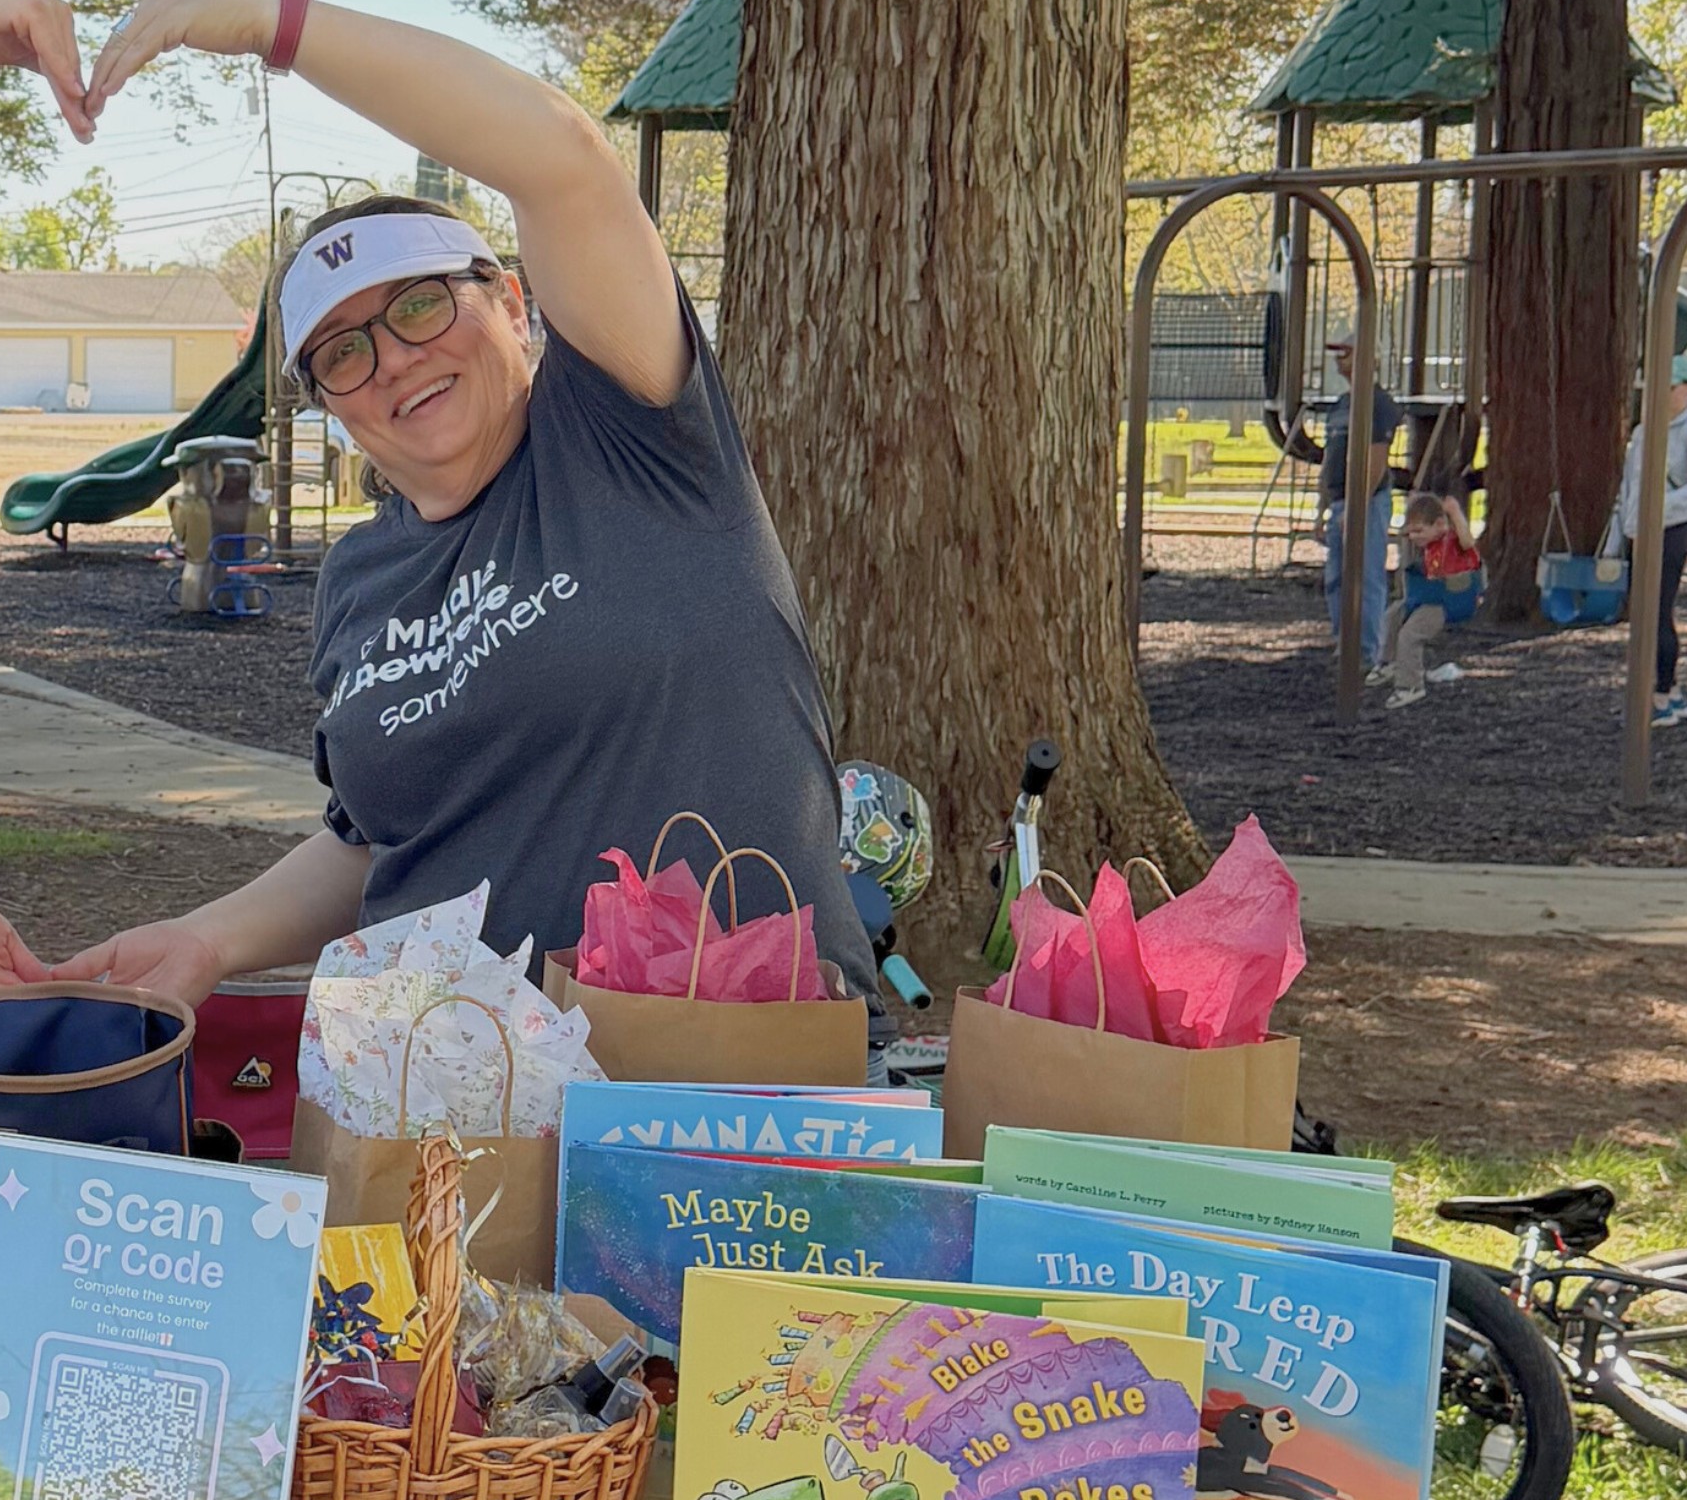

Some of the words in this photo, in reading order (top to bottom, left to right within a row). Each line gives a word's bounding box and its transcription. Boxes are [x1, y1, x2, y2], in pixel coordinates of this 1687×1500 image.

[314, 231, 354, 271] W
[379, 572, 579, 737] somewhere
[76, 1178, 224, 1245] Scan
[660, 1189, 811, 1233] Maybe
[1016, 1174, 1048, 1187] words
[1050, 1179, 1064, 1192] by
[1066, 1181, 1117, 1199] Caroline
[1134, 1193, 1167, 1208] Perry
[1203, 1204, 1254, 1221] pictures
[1257, 1211, 1271, 1225] by
[1273, 1215, 1315, 1233] Sydney
[1317, 1223, 1361, 1240] Hanson
[62, 1233, 111, 1274] Qr
[121, 1243, 224, 1288] Code
[692, 1233, 786, 1271] Just
[801, 1242, 885, 1277] Ask
[71, 1296, 88, 1310] for
[92, 1302, 100, 1312] a
[104, 1303, 153, 1322] chance
[157, 1312, 171, 1324] to
[174, 1316, 210, 1330] enter
[74, 1277, 140, 1299] Complete
[143, 1288, 163, 1302] the
[168, 1294, 212, 1314] survey
[1037, 1252, 1116, 1287] The
[1127, 1250, 1223, 1309] Day
[1233, 1272, 1355, 1351] Leap
[97, 1322, 118, 1336] the
[929, 1338, 1010, 1393] Blake
[1200, 1315, 1359, 1417] RED
[962, 1432, 1011, 1468] the
[1013, 1381, 1147, 1440] Snake
